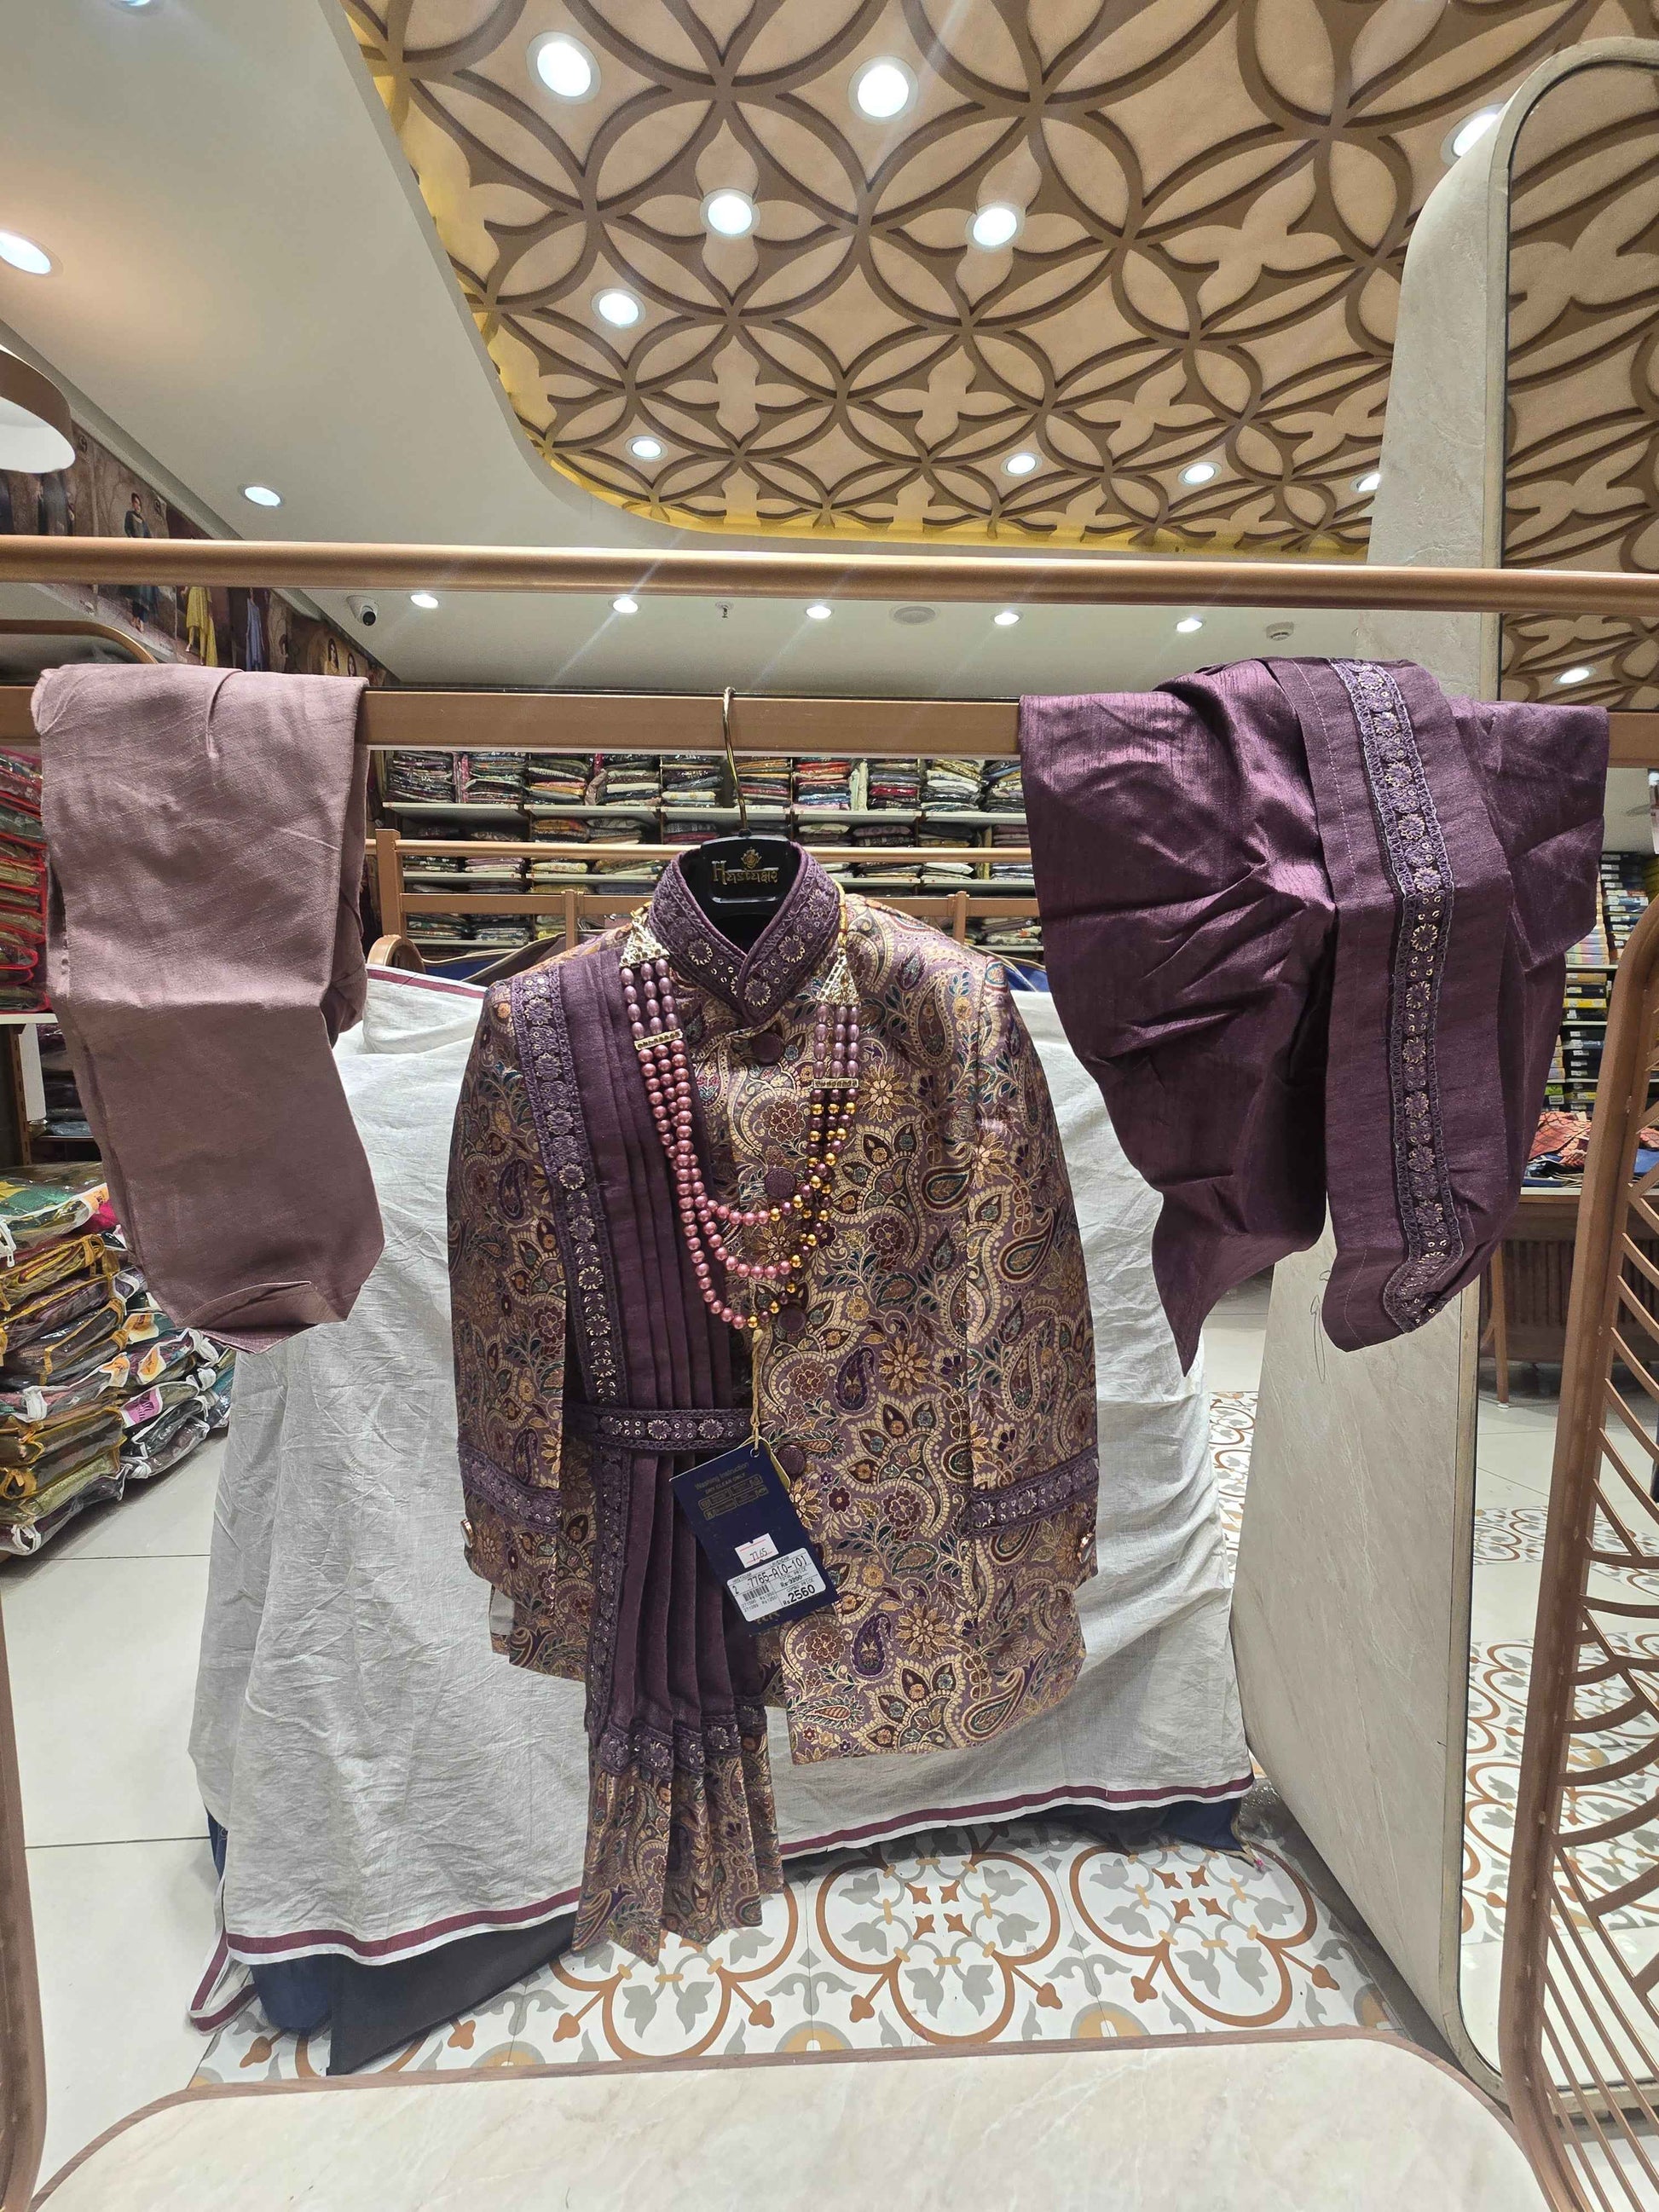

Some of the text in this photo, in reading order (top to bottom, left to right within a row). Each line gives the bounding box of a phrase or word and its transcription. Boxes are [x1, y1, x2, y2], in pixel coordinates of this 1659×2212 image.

[705, 1486, 715, 1494] DRY
[716, 1479, 732, 1490] CLEAN
[732, 1472, 745, 1481] ONLY
[749, 1547, 767, 1562] 7765
[732, 1585, 739, 1595] 2
